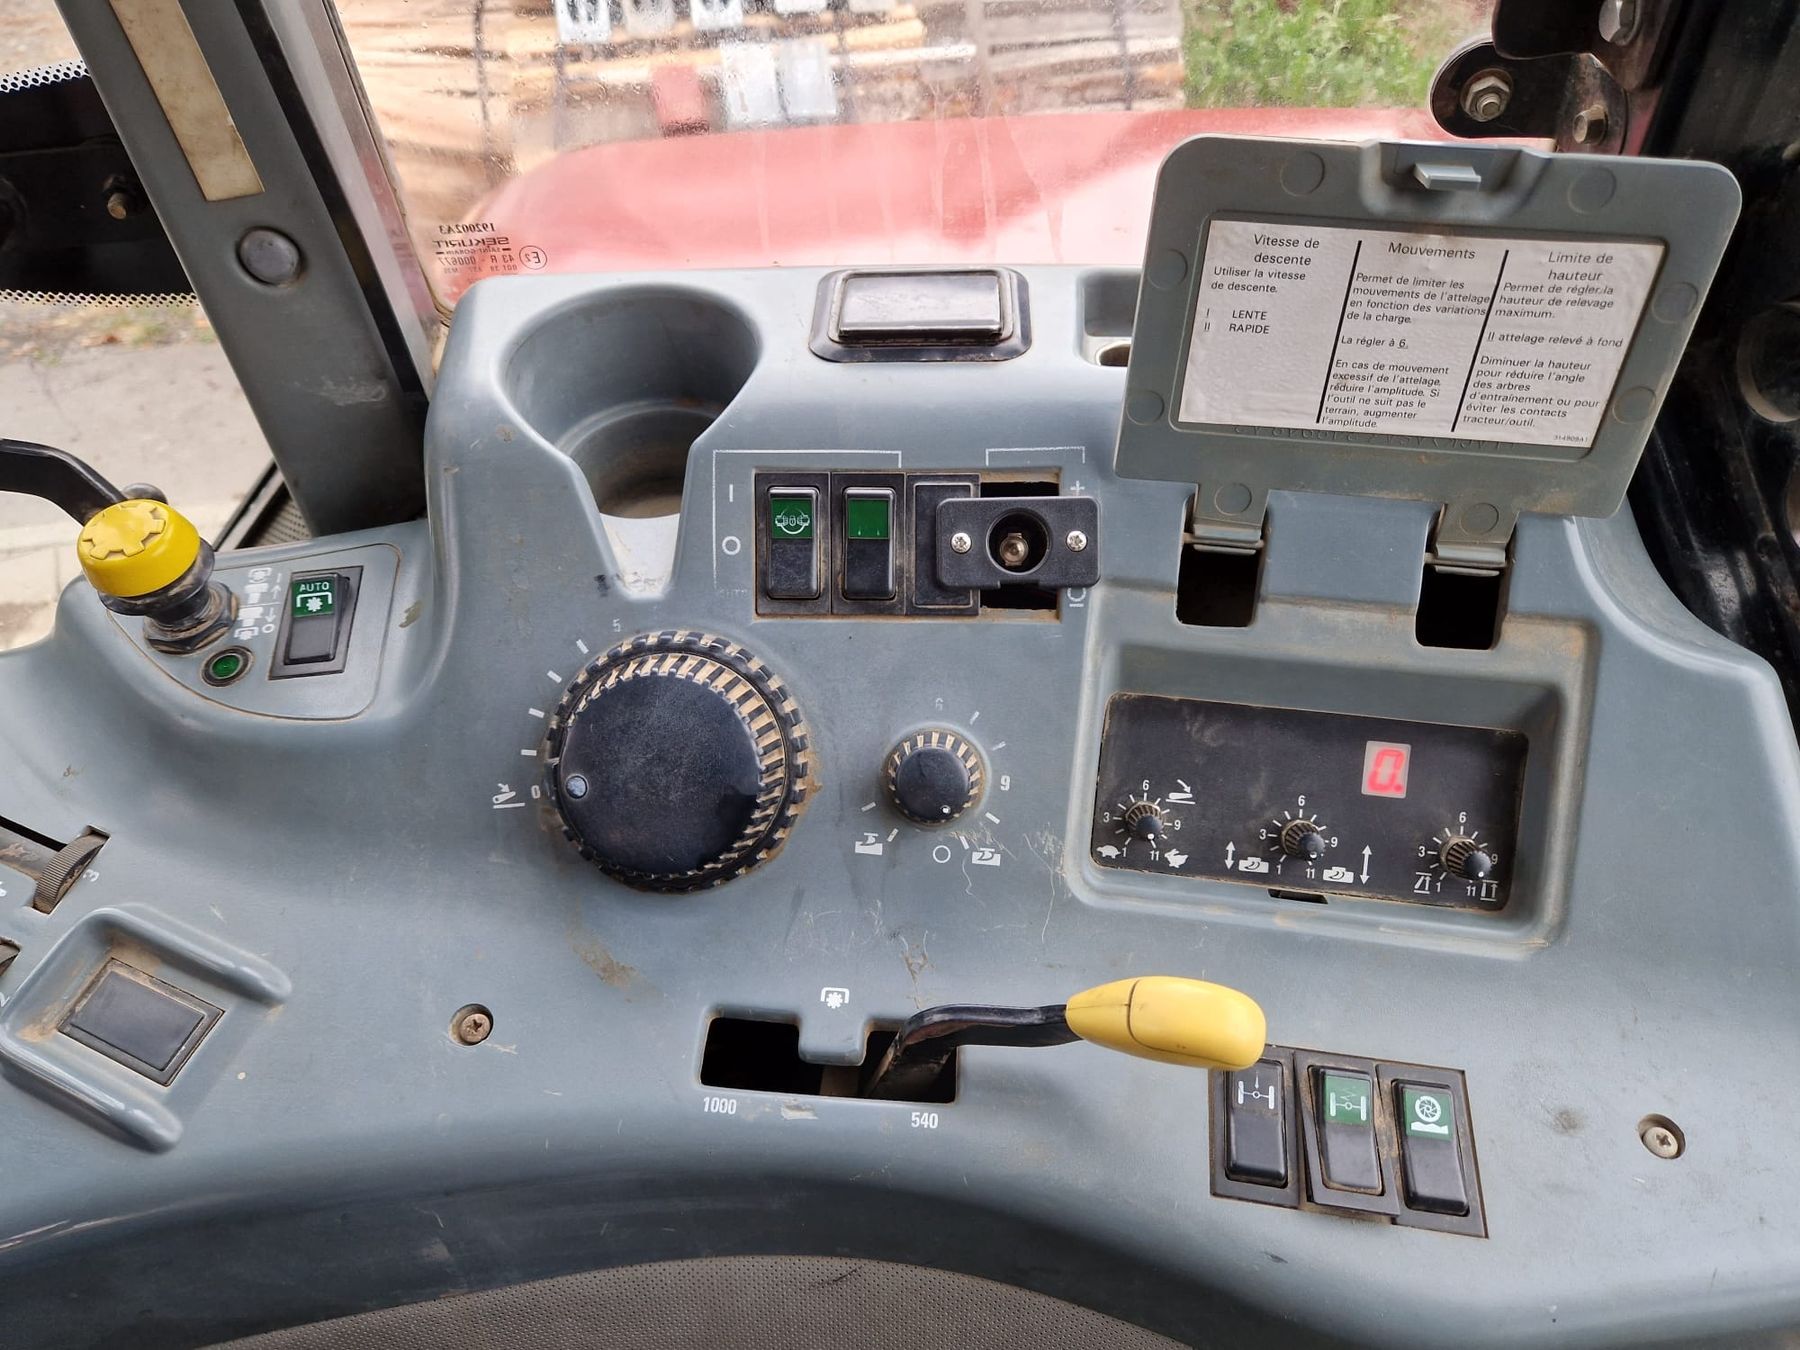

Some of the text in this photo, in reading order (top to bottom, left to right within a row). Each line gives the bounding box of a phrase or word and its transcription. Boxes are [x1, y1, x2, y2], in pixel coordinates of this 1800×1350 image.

[1254, 234, 1319, 248] Vitesse de
[1388, 242, 1476, 259] Mouvements
[1254, 252, 1311, 265] descente
[1548, 252, 1614, 264] Limite de
[1214, 266, 1305, 280] Utiliser la vitesse
[1548, 269, 1604, 281] hauteur
[1211, 281, 1223, 289] de
[1356, 272, 1464, 289] Permet de limiter les
[1504, 282, 1544, 292] Permet
[1548, 284, 1562, 293] de
[1604, 285, 1614, 294] la
[1353, 287, 1490, 304] mouvements de l'attelage
[1366, 300, 1409, 310] fonction
[1413, 303, 1431, 312] des
[1436, 305, 1486, 315] variations
[1499, 295, 1614, 310] hauteur de relevage
[1232, 310, 1267, 320] LENTE
[1346, 311, 1359, 320] de
[1363, 312, 1372, 320] la
[1229, 323, 1270, 334] RAPIDE
[1340, 336, 1352, 344] La
[1356, 337, 1384, 347] régler
[1388, 338, 1395, 346] à
[1499, 333, 1545, 345] attelage
[1548, 336, 1582, 345] relevé
[1586, 337, 1593, 346] à
[1597, 337, 1623, 347] fond
[1335, 360, 1449, 374] En cas de mouvement
[1480, 356, 1592, 370] Diminuer la hauteur
[1333, 373, 1373, 381] excessif
[1377, 374, 1389, 382] de
[1476, 369, 1585, 384] pour réduire l'angle
[1329, 383, 1364, 393] réduire
[1430, 389, 1440, 397] Si
[1473, 380, 1531, 391] des arbres
[1327, 394, 1355, 403] l'outil
[1374, 398, 1393, 406] suit
[1396, 400, 1414, 408] pas
[1418, 400, 1426, 408] le
[1556, 398, 1571, 406] ou
[1574, 399, 1600, 408] pour
[1363, 410, 1417, 419] augmenter
[1466, 403, 1568, 417] éviter les contacts
[300, 582, 329, 592] AUTO
[613, 618, 621, 633] 5
[1000, 775, 1011, 791] 9
[1143, 780, 1150, 790] 6
[1298, 795, 1306, 806] 6
[1103, 812, 1110, 822] 3
[1459, 812, 1466, 823] 6
[1174, 820, 1181, 830] 9
[1260, 829, 1266, 839] 3
[1331, 837, 1338, 847] 9
[1122, 847, 1126, 857] 1
[1150, 850, 1159, 861] 11
[1418, 846, 1425, 857] 3
[1491, 854, 1498, 864] 9
[1277, 864, 1281, 874] 1
[1306, 868, 1315, 879] 11
[83, 869, 99, 882] 3
[1436, 882, 1441, 893] 1
[1466, 886, 1476, 897] 11
[703, 1096, 736, 1115] 1000
[911, 1112, 938, 1129] 540
